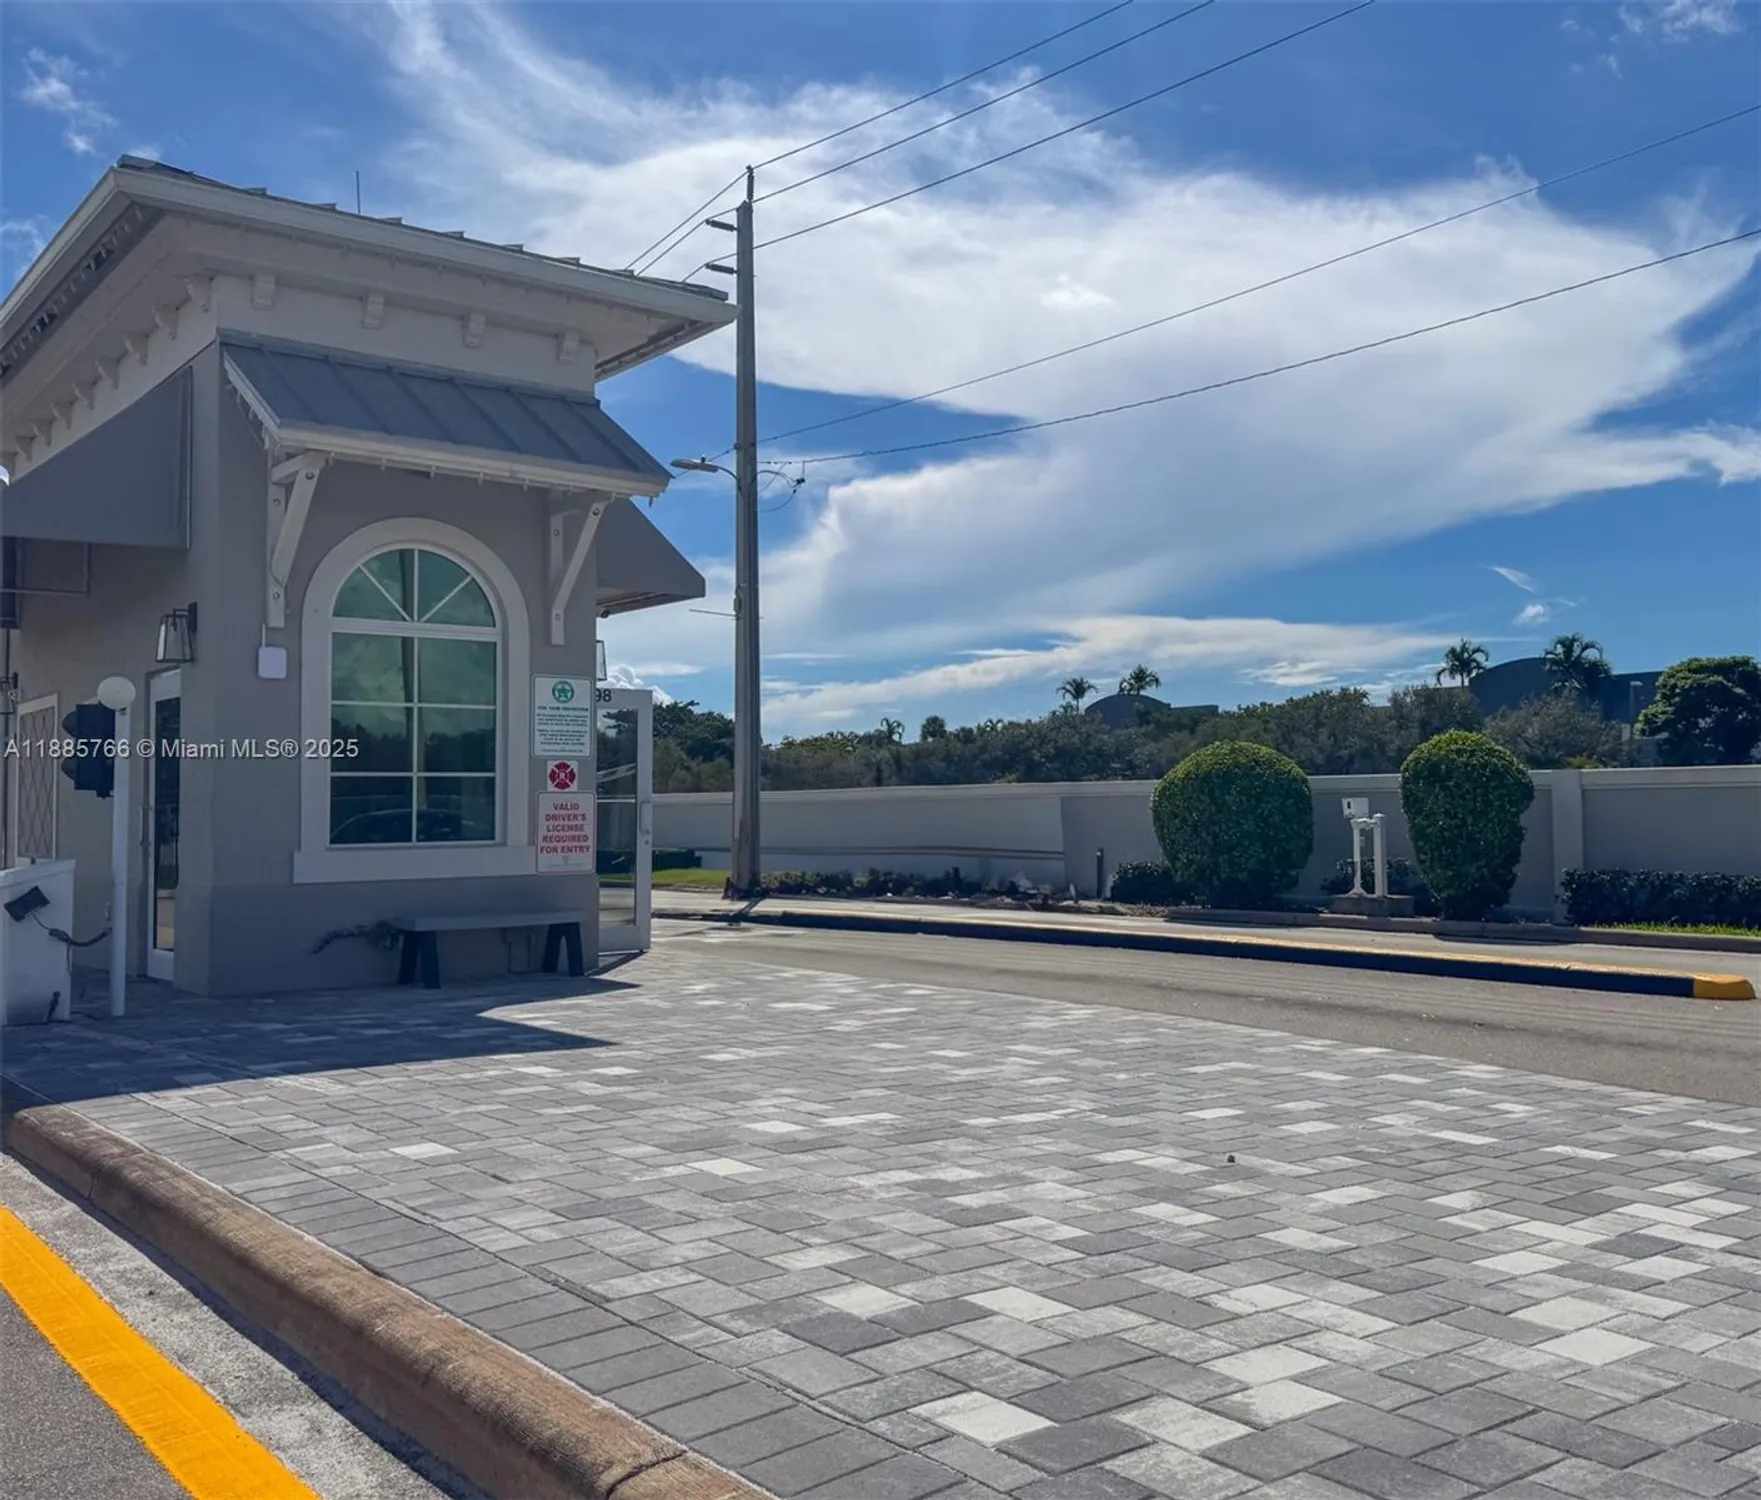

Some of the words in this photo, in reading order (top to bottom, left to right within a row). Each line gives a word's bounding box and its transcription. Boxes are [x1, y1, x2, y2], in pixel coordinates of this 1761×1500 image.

[552, 803, 580, 811] VALID
[545, 813, 587, 822] DRIVER'S
[546, 823, 584, 833] LICENSE
[542, 834, 589, 844] REQUIRED
[540, 846, 559, 854] FOR
[561, 845, 590, 853] ENTRY
